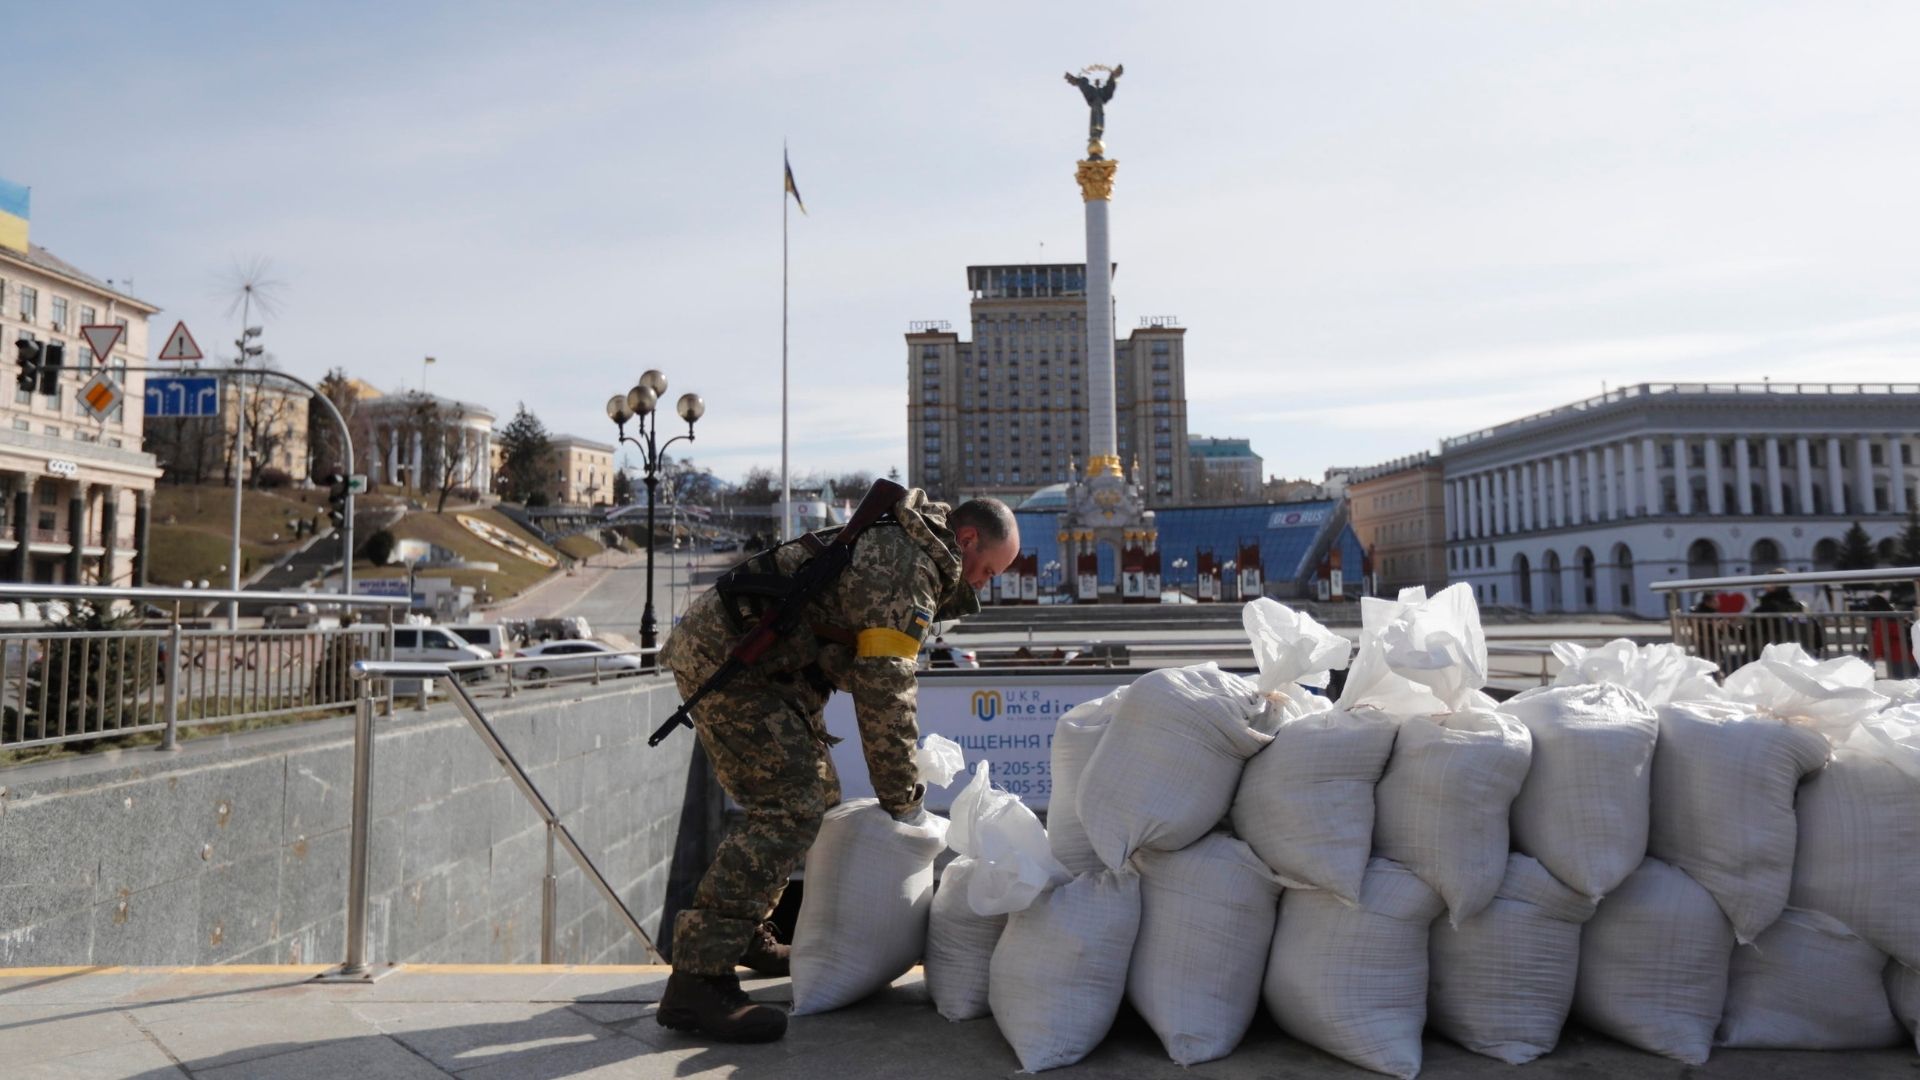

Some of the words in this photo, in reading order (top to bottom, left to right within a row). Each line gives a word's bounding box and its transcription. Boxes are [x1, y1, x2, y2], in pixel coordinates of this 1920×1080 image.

[909, 320, 952, 330] ГОТЕЛЬ
[1140, 315, 1180, 326] HOTEL
[1006, 690, 1040, 701] UKR
[968, 761, 1052, 776] 04-205-53
